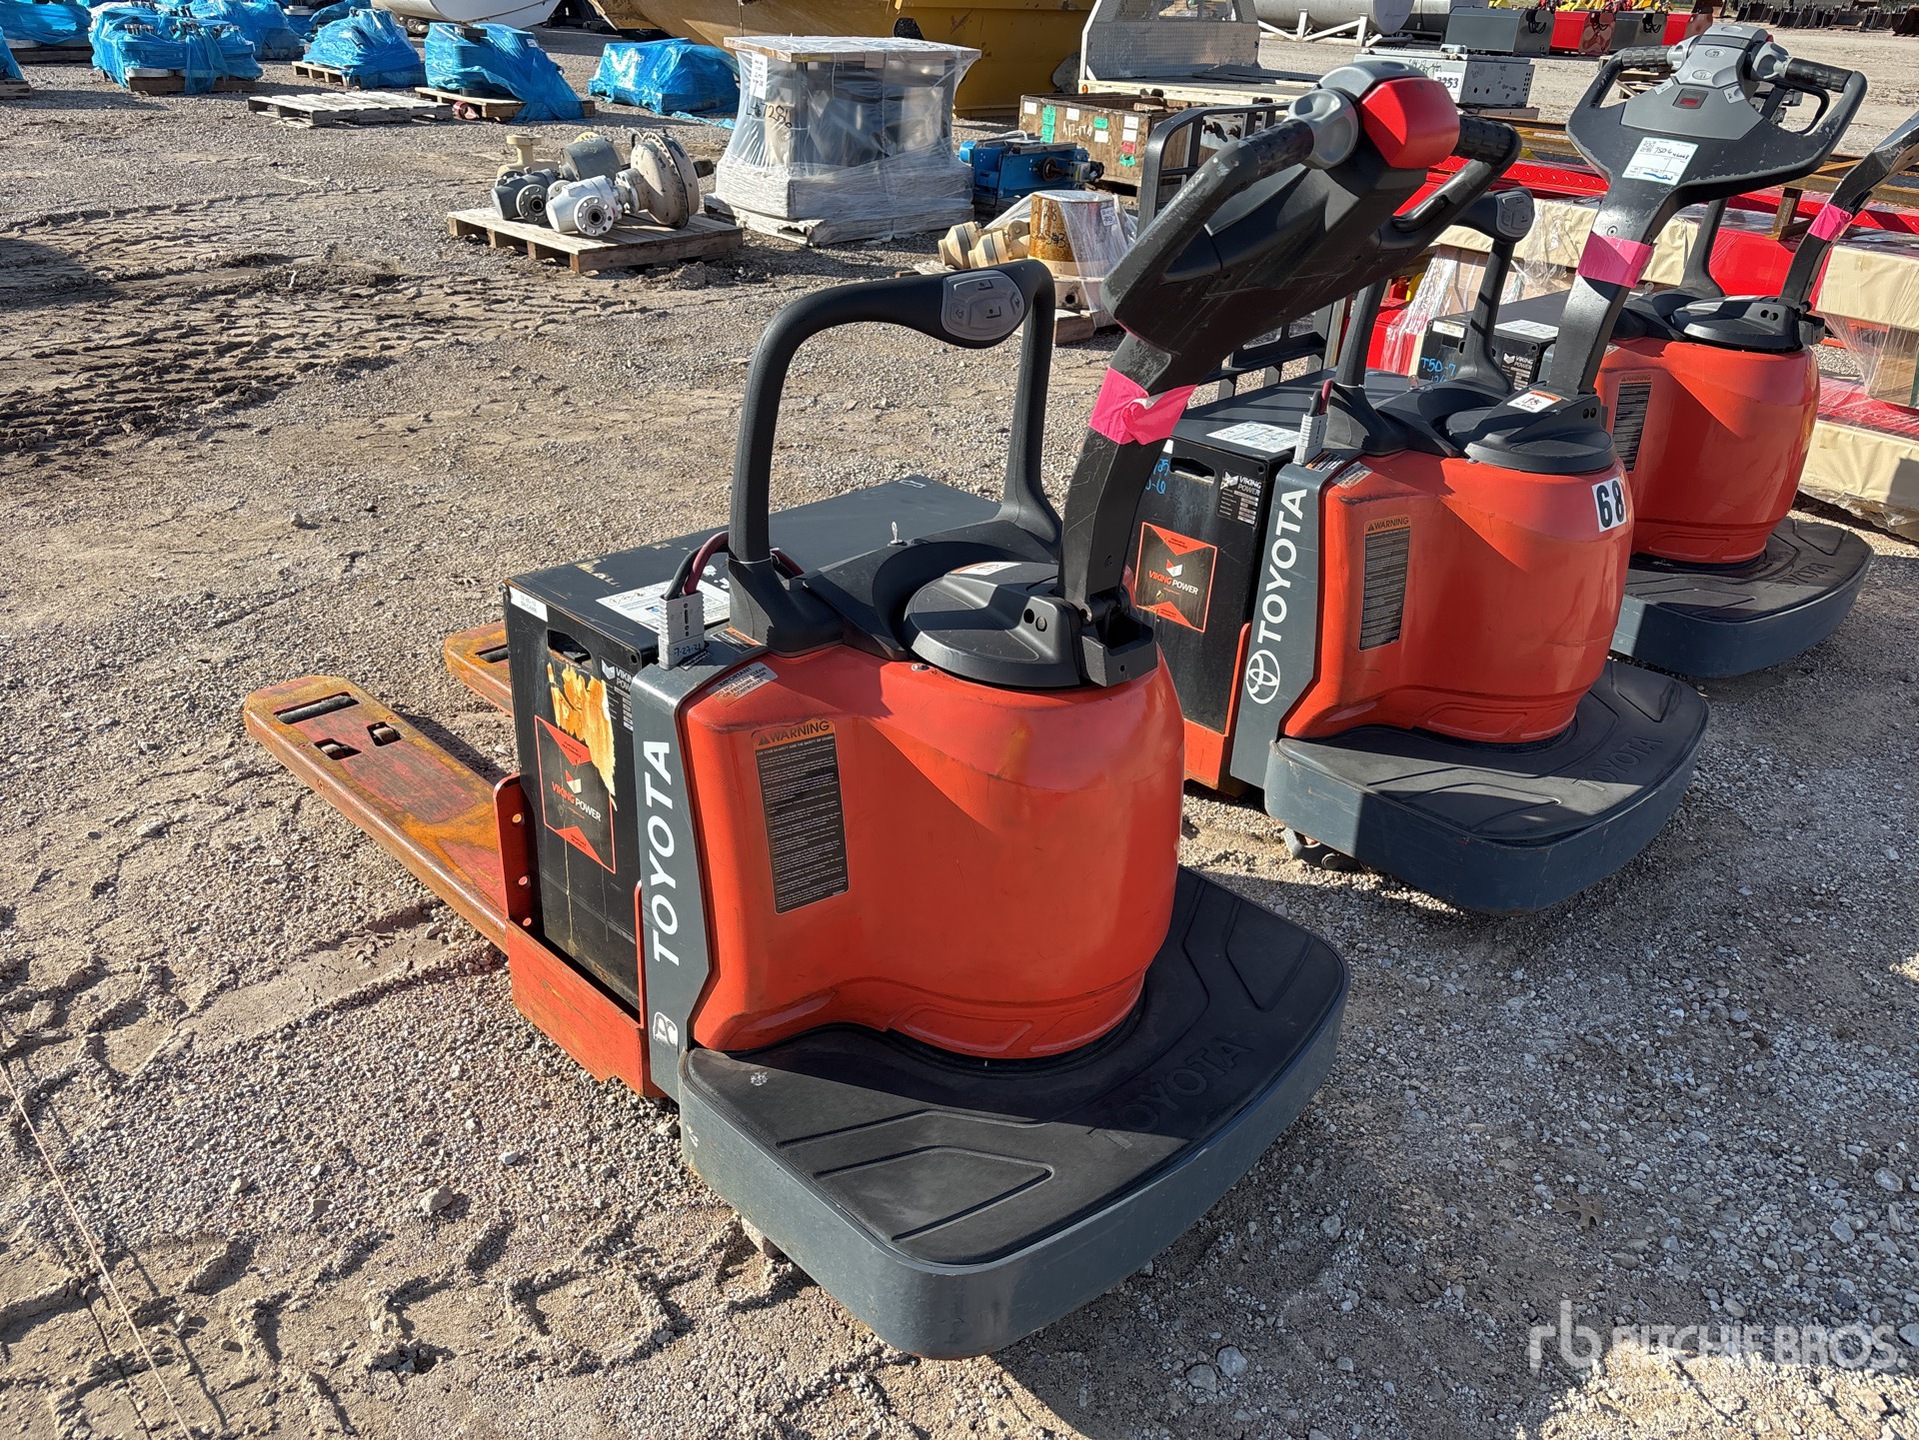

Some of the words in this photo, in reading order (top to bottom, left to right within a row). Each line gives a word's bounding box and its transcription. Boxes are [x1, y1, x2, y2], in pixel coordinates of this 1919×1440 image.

[1237, 484, 1261, 497] POWER
[1239, 475, 1263, 490] VIKING
[1597, 480, 1625, 528] 68
[1374, 517, 1409, 531] WARNING
[1257, 489, 1308, 644] TOYOTA
[1148, 570, 1173, 586] VIKING
[1171, 579, 1199, 596] POWER
[770, 721, 830, 742] WARNING
[551, 780, 575, 804] VIKING
[575, 797, 602, 823] POWER
[644, 740, 679, 967] TOYOTA
